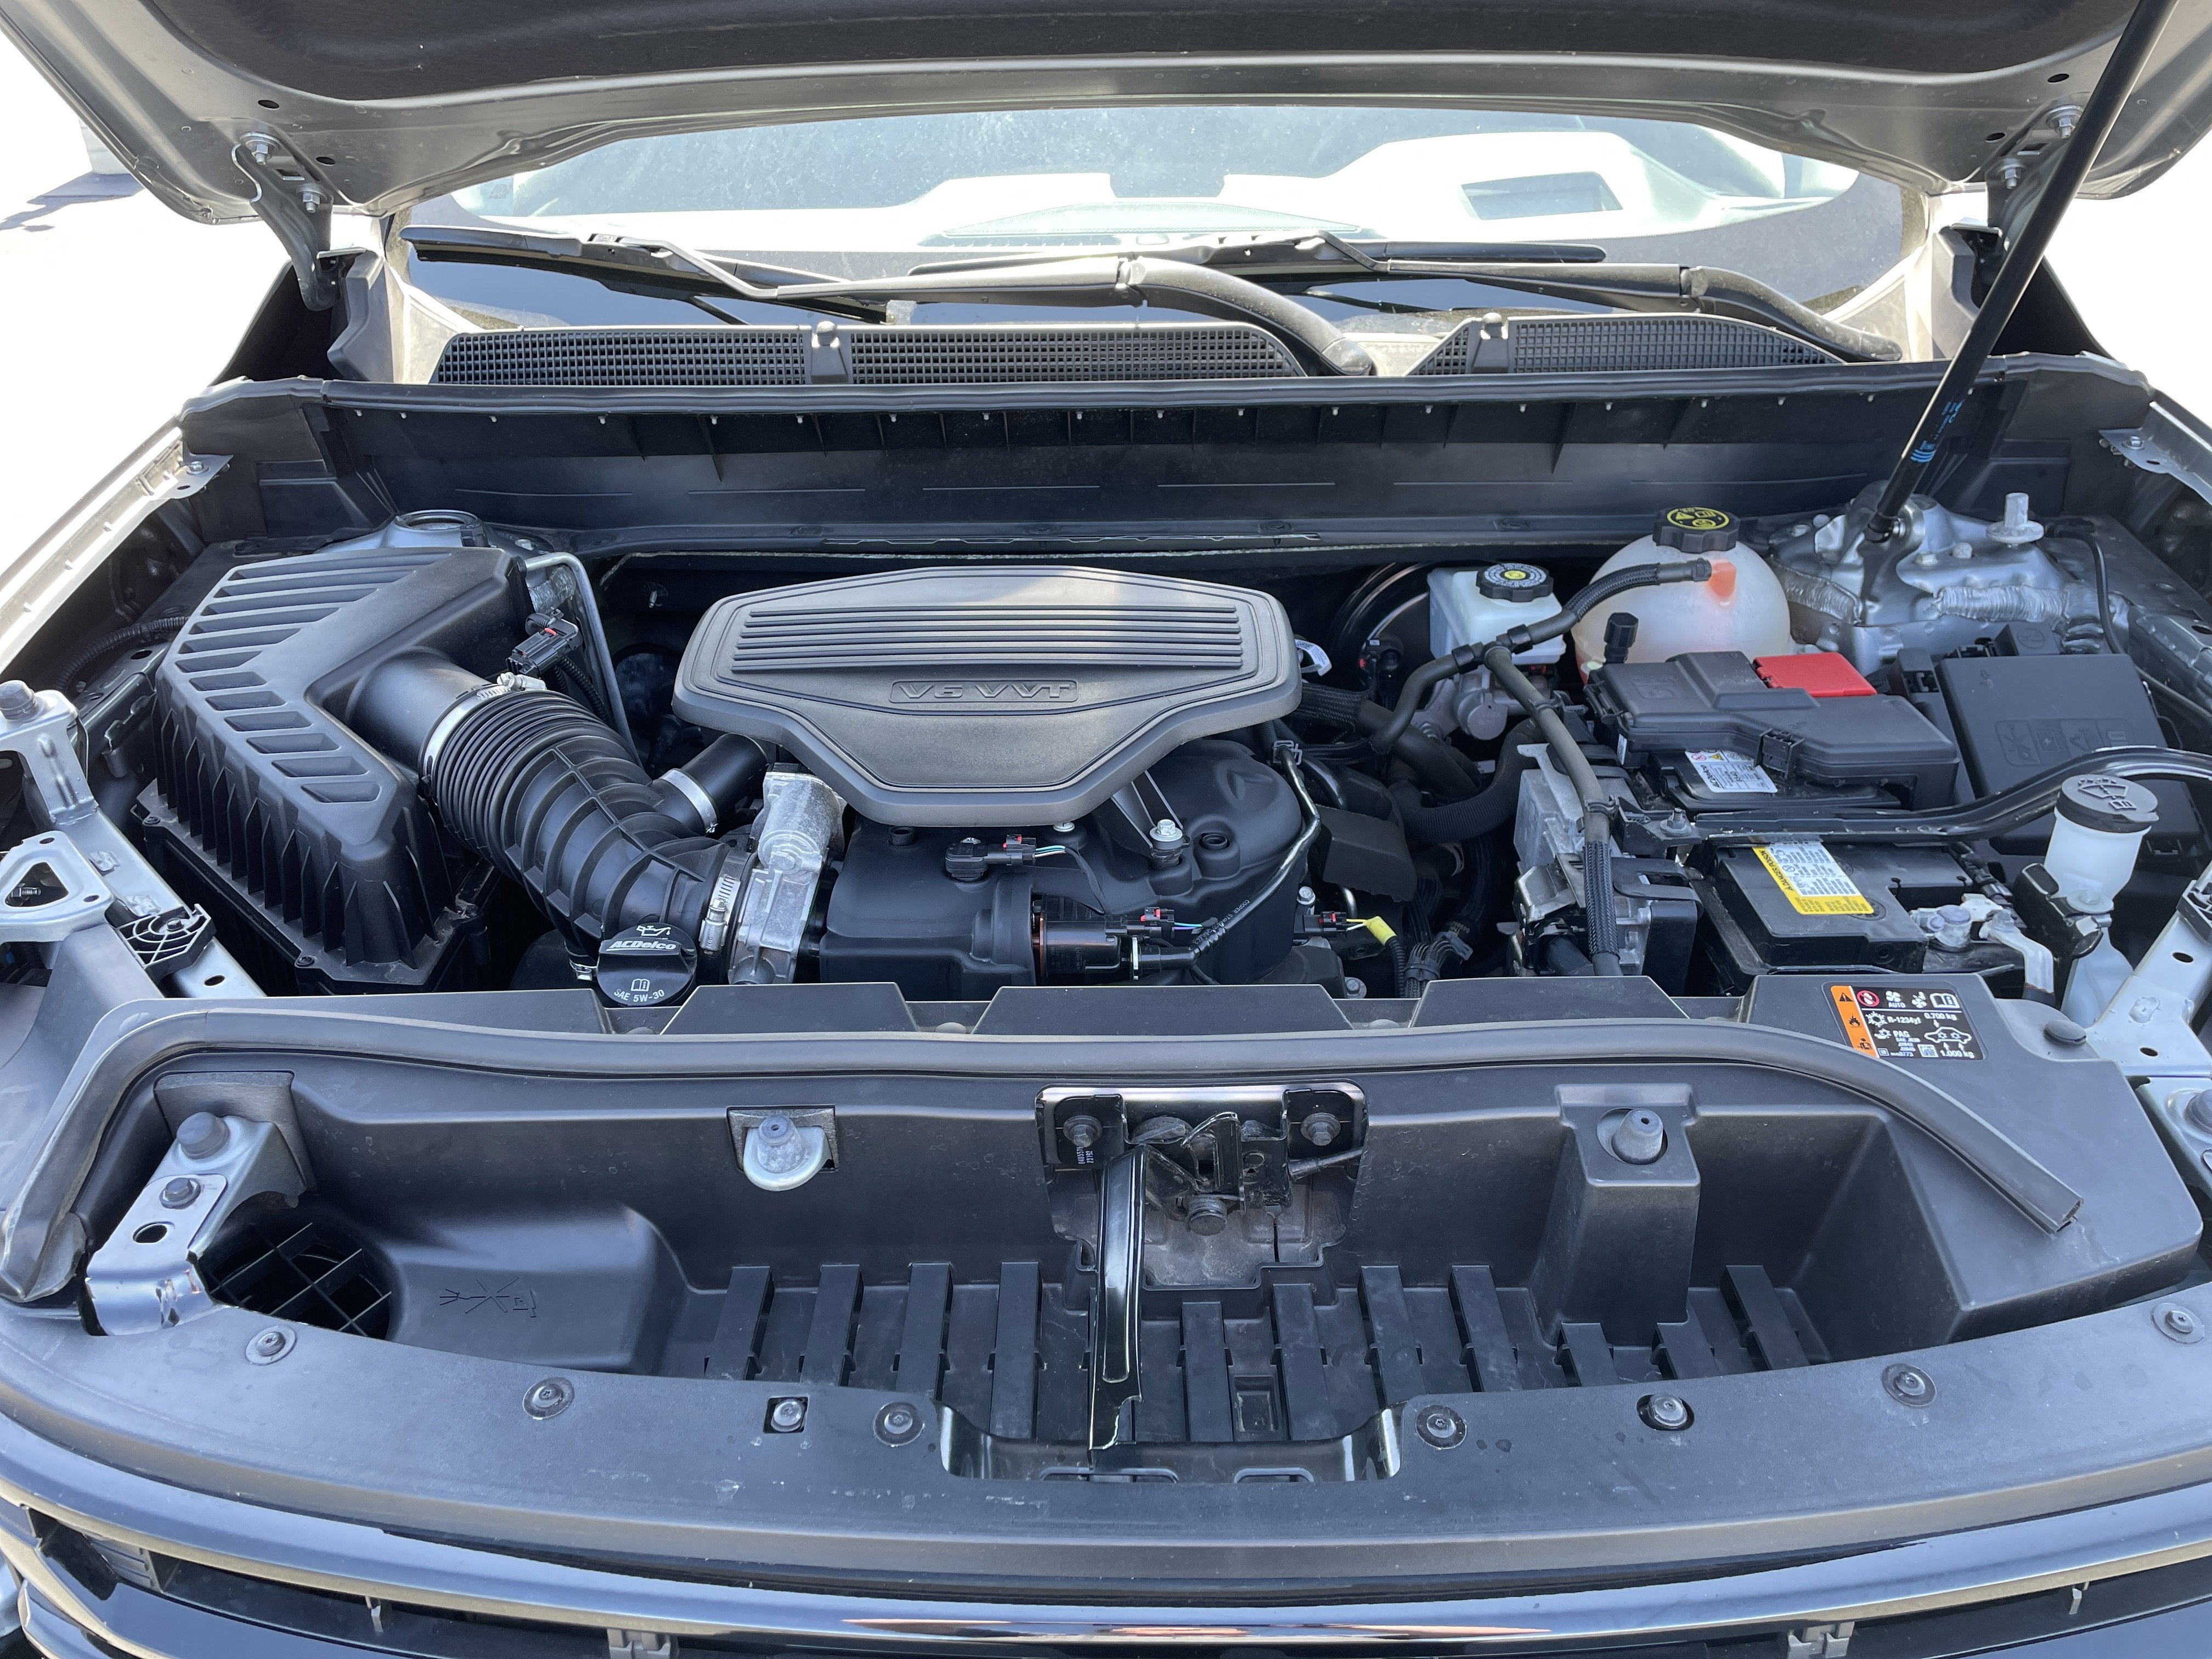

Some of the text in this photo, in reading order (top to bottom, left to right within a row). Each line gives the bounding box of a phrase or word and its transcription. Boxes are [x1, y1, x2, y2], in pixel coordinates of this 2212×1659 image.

[900, 684, 1071, 698] V6 VVT
[1233, 899, 1250, 913] COOPER
[609, 940, 676, 950] ACDelco
[614, 989, 664, 1002] SAE 5W-30
[1940, 1049, 1974, 1058] 1.000 kg
